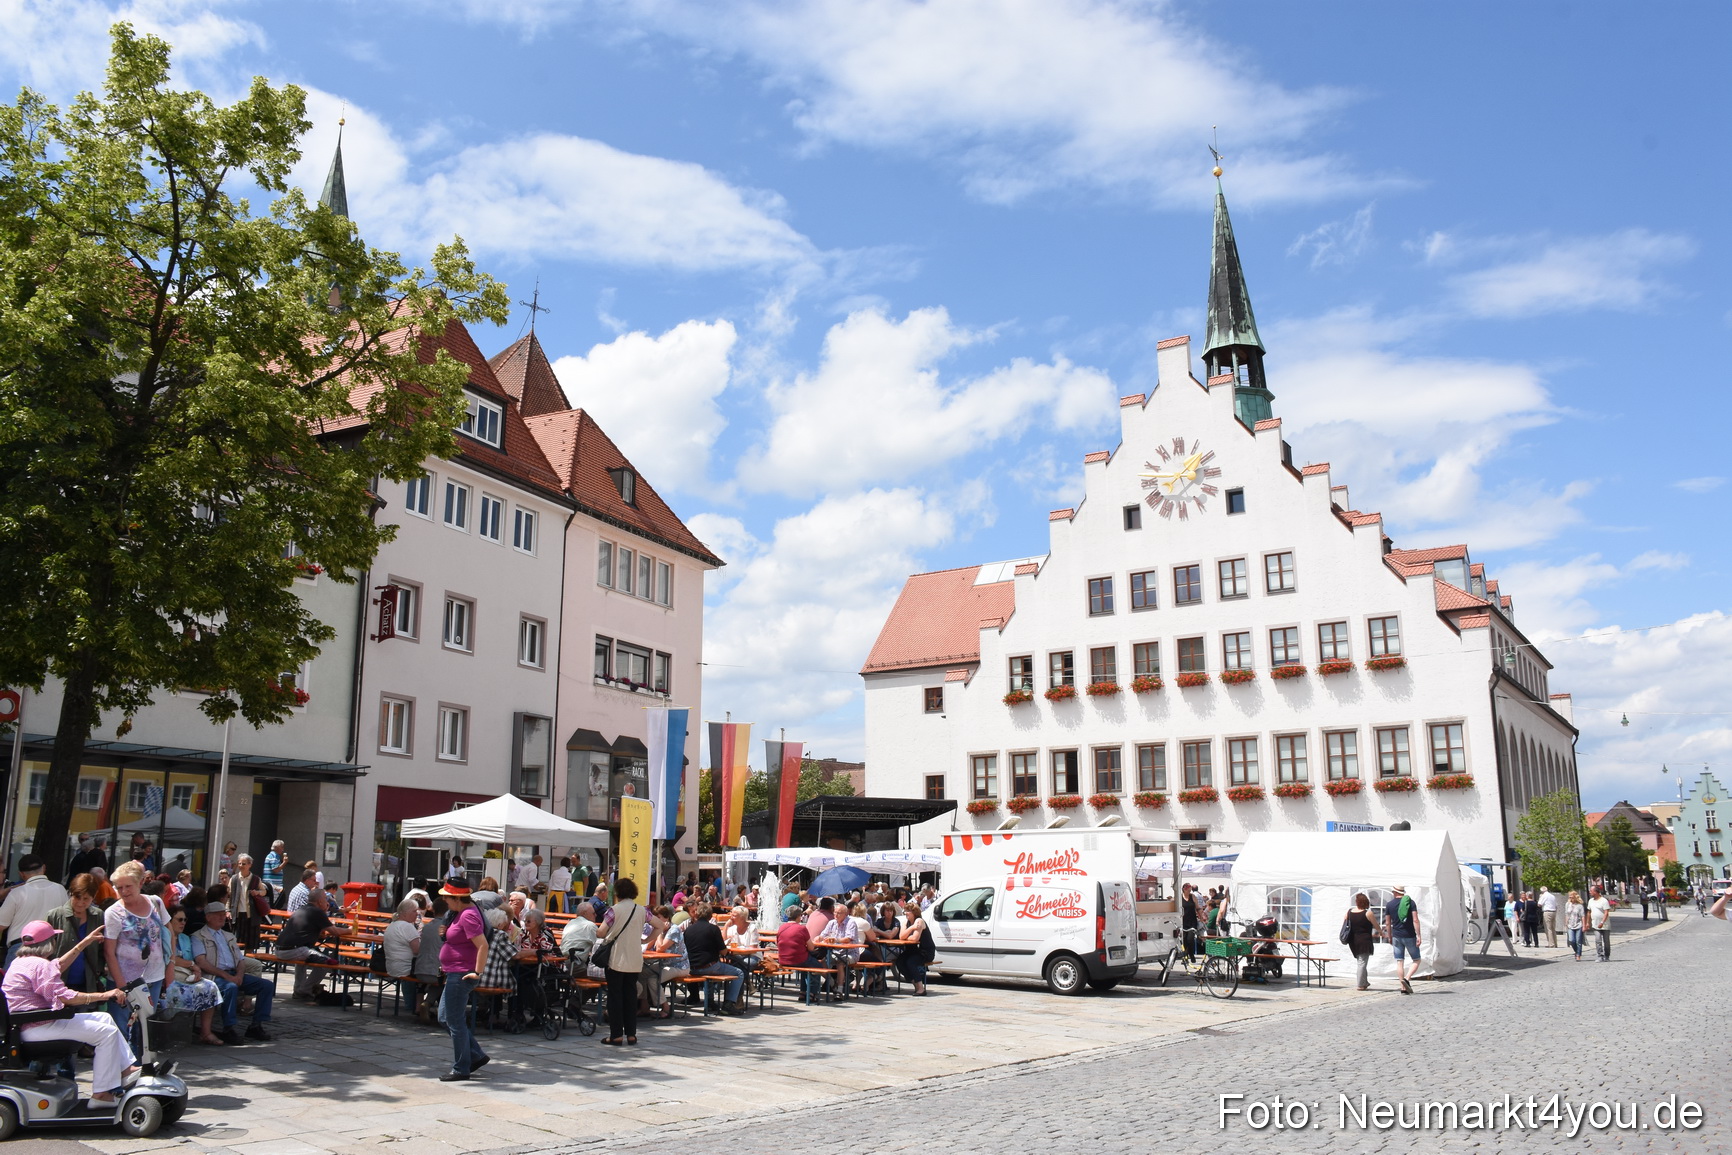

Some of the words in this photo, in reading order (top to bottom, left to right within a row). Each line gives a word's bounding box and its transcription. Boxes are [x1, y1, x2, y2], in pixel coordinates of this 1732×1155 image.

[1144, 461, 1161, 472] X
[382, 598, 393, 636] Achatz
[1016, 891, 1081, 919] Lehmeier's
[1056, 909, 1083, 917] IMBISS
